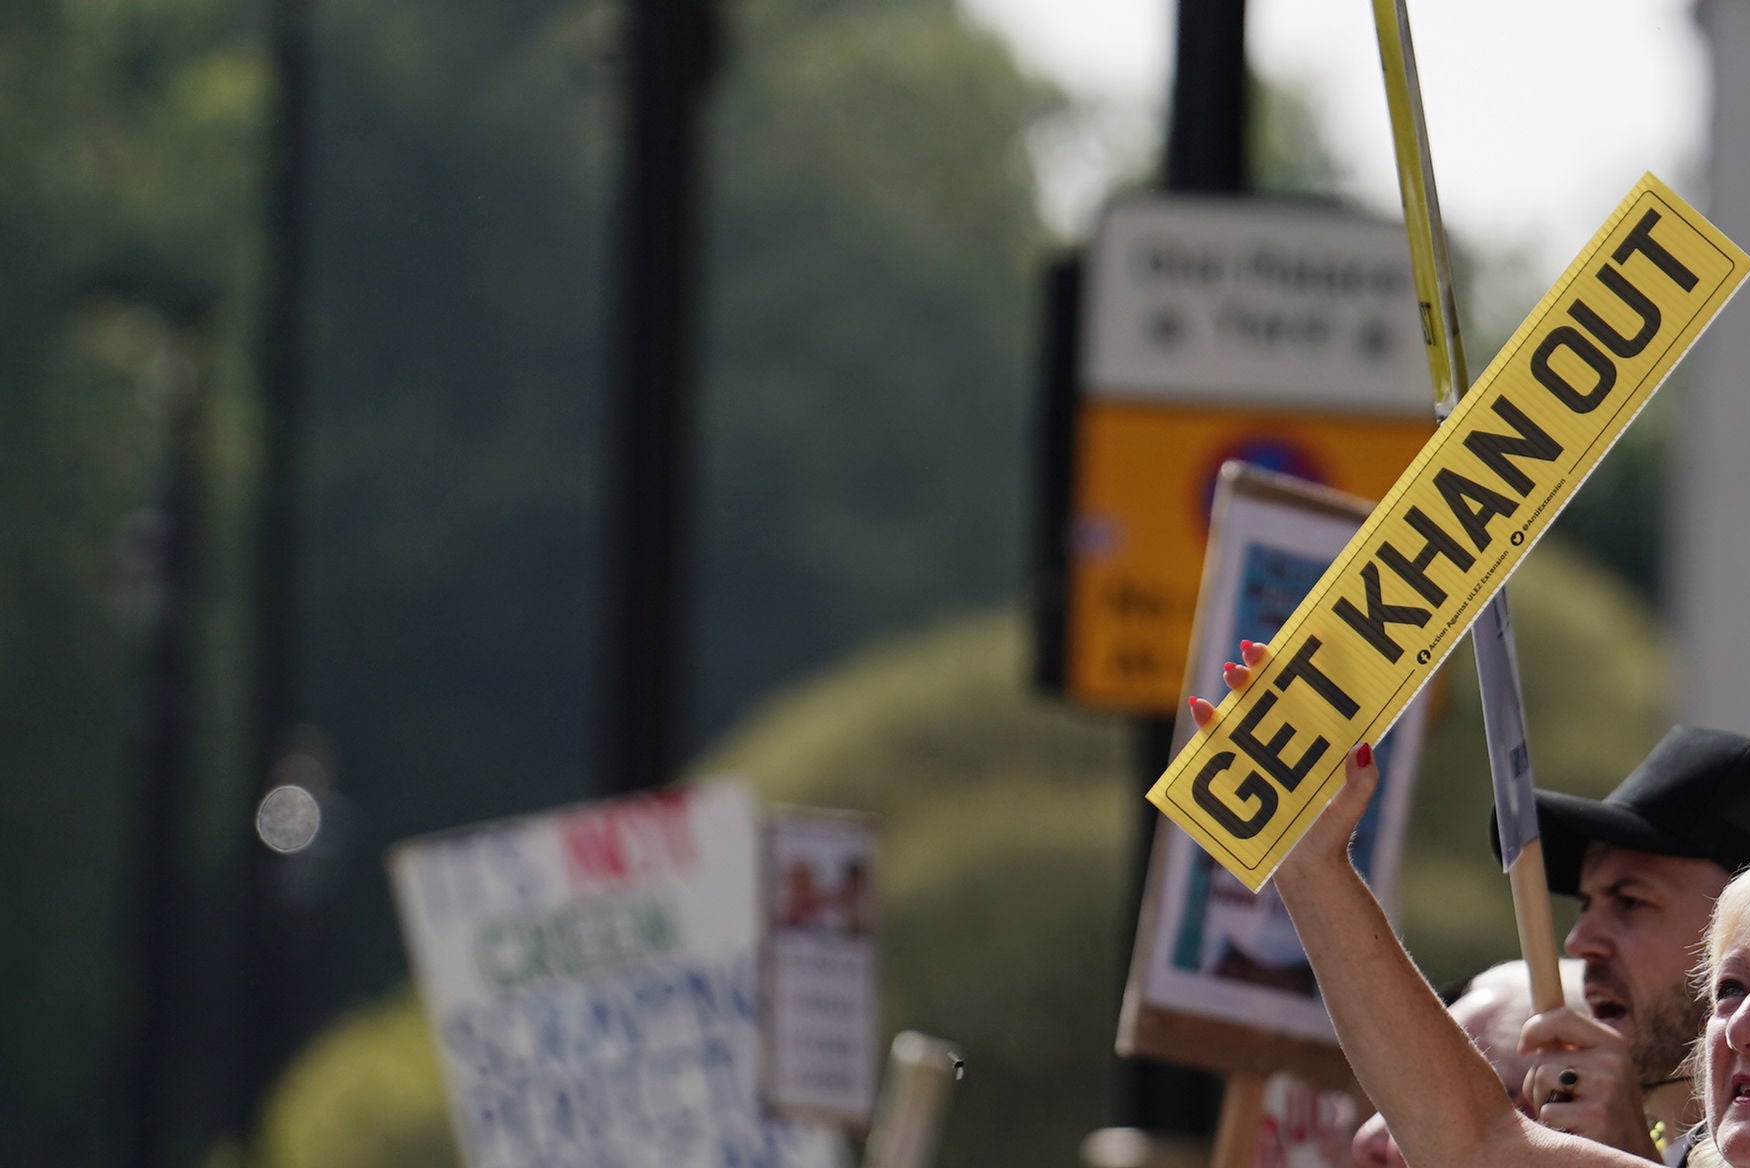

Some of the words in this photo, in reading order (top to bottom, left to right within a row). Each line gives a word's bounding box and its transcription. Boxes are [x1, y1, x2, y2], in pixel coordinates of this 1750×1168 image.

[1193, 636, 1360, 839] GET
[1332, 395, 1563, 664] KHAN
[1531, 208, 1699, 414] OUT
[1523, 478, 1566, 532] @AntiExtension
[1428, 627, 1448, 651] Action
[1447, 600, 1470, 629] Against
[1467, 583, 1482, 602] ULEZ
[1480, 550, 1510, 584] Extension
